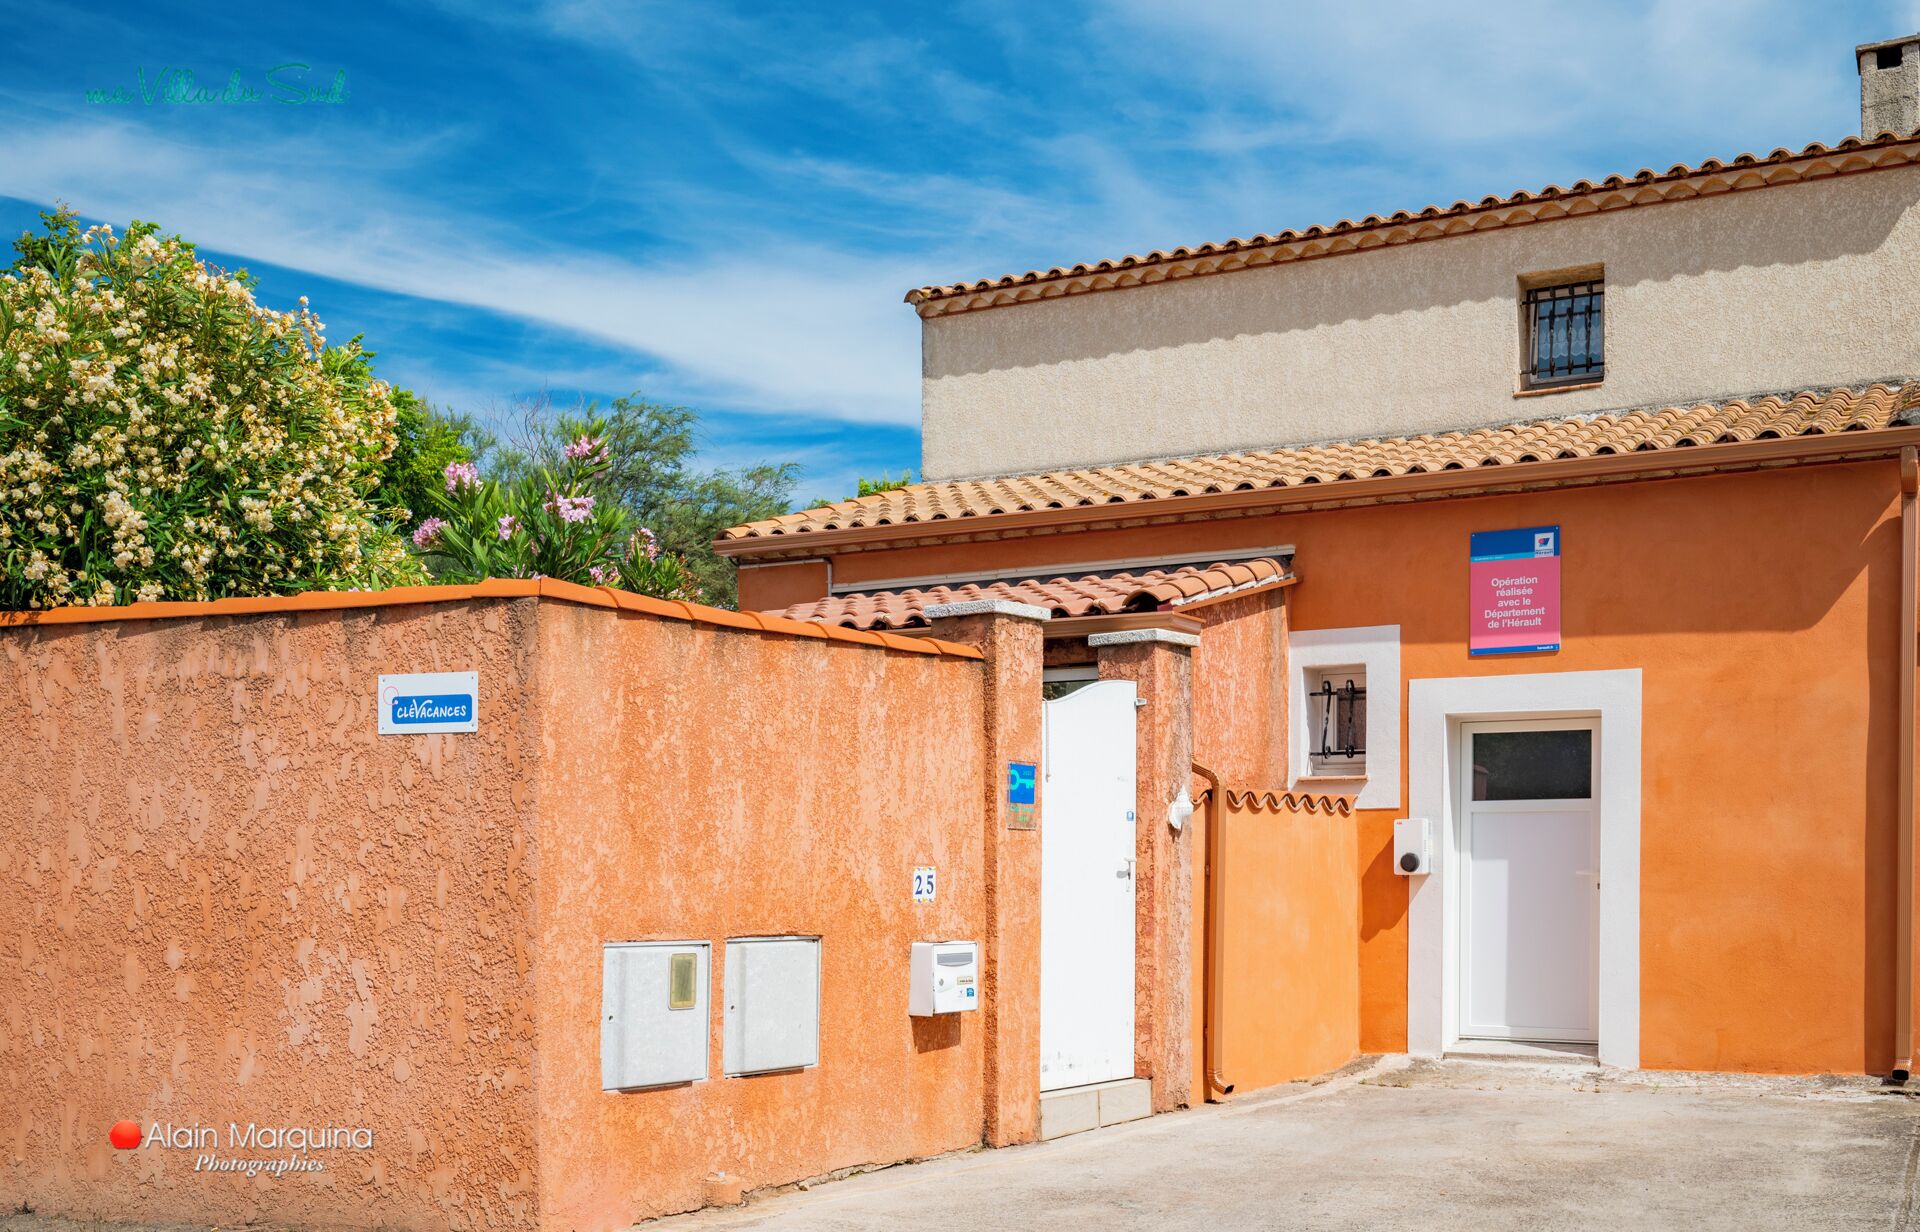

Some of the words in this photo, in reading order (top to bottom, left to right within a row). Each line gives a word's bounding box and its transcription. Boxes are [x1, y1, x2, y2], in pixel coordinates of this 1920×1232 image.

[1491, 576, 1538, 588] Opération
[1496, 586, 1533, 597] réalisée
[1498, 599, 1520, 607] avec
[1522, 597, 1531, 606] le
[1484, 607, 1545, 619] Département
[1488, 620, 1499, 629] de
[1502, 618, 1542, 628] l'Hérault
[914, 874, 934, 895] 25
